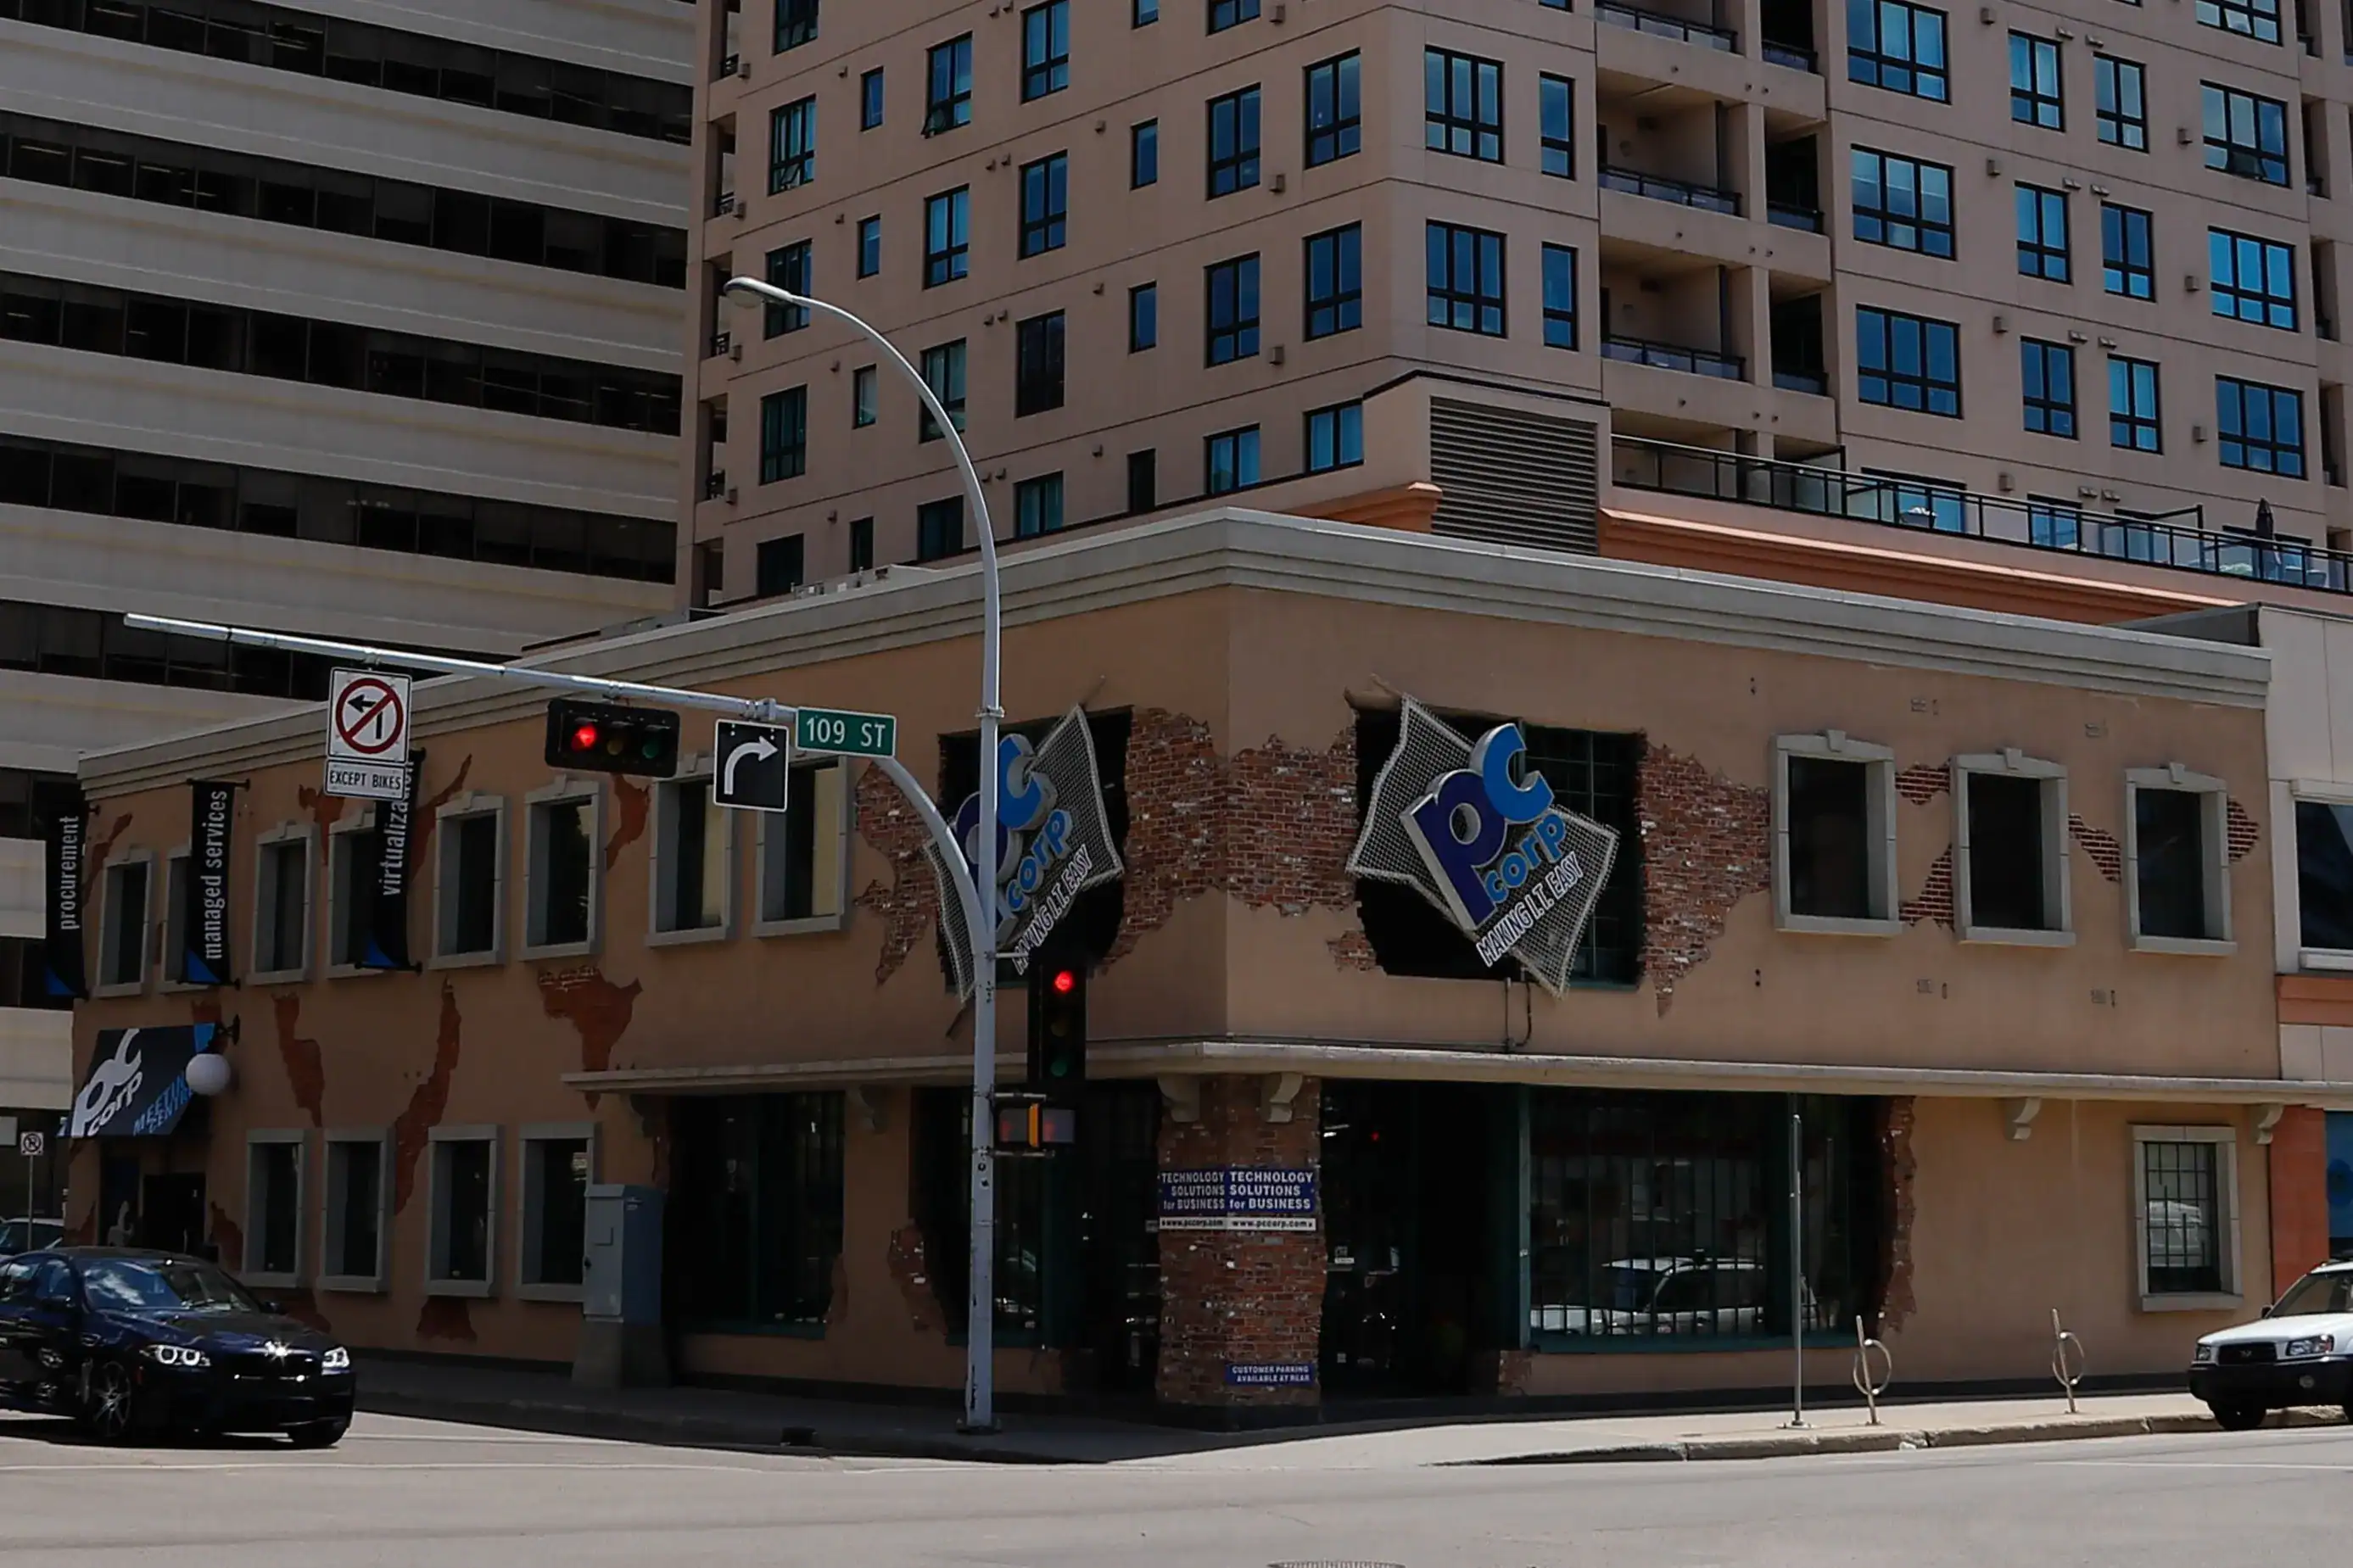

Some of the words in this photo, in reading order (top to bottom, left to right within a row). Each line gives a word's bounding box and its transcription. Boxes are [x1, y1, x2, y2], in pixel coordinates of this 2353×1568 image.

[805, 717, 846, 745] 109
[860, 723, 886, 748] ST
[329, 769, 367, 786] EXCEPT
[372, 773, 402, 790] BIKES
[201, 790, 227, 869] services
[1005, 807, 1075, 916] corp
[1061, 843, 1093, 896] EASY
[1483, 812, 1568, 905] corp
[59, 814, 81, 930] procurement
[200, 875, 226, 960] managed
[1475, 901, 1534, 968] MAKING
[1525, 885, 1555, 919] I.T.
[1545, 851, 1585, 901] EASY
[87, 1071, 143, 1137] corp
[132, 1072, 187, 1137] MEETIN
[1161, 1171, 1226, 1184] TECHNOLOGY
[1229, 1171, 1314, 1184] TECHNOLOGY
[1229, 1184, 1301, 1197] SOLUTIONS
[1163, 1199, 1176, 1210] for
[1176, 1197, 1226, 1210] BUSINESS
[1171, 1185, 1226, 1197] SOLUTIONS
[1229, 1198, 1246, 1210] for
[1248, 1197, 1311, 1210] BUSINESS
[1232, 1219, 1308, 1229] www.pccorp.com
[1232, 1364, 1274, 1375] CUSTOMER
[1275, 1364, 1310, 1374] PARKING
[1236, 1374, 1277, 1383] AVAILABLE
[1279, 1374, 1288, 1382] AT
[1289, 1374, 1311, 1382] REAR
